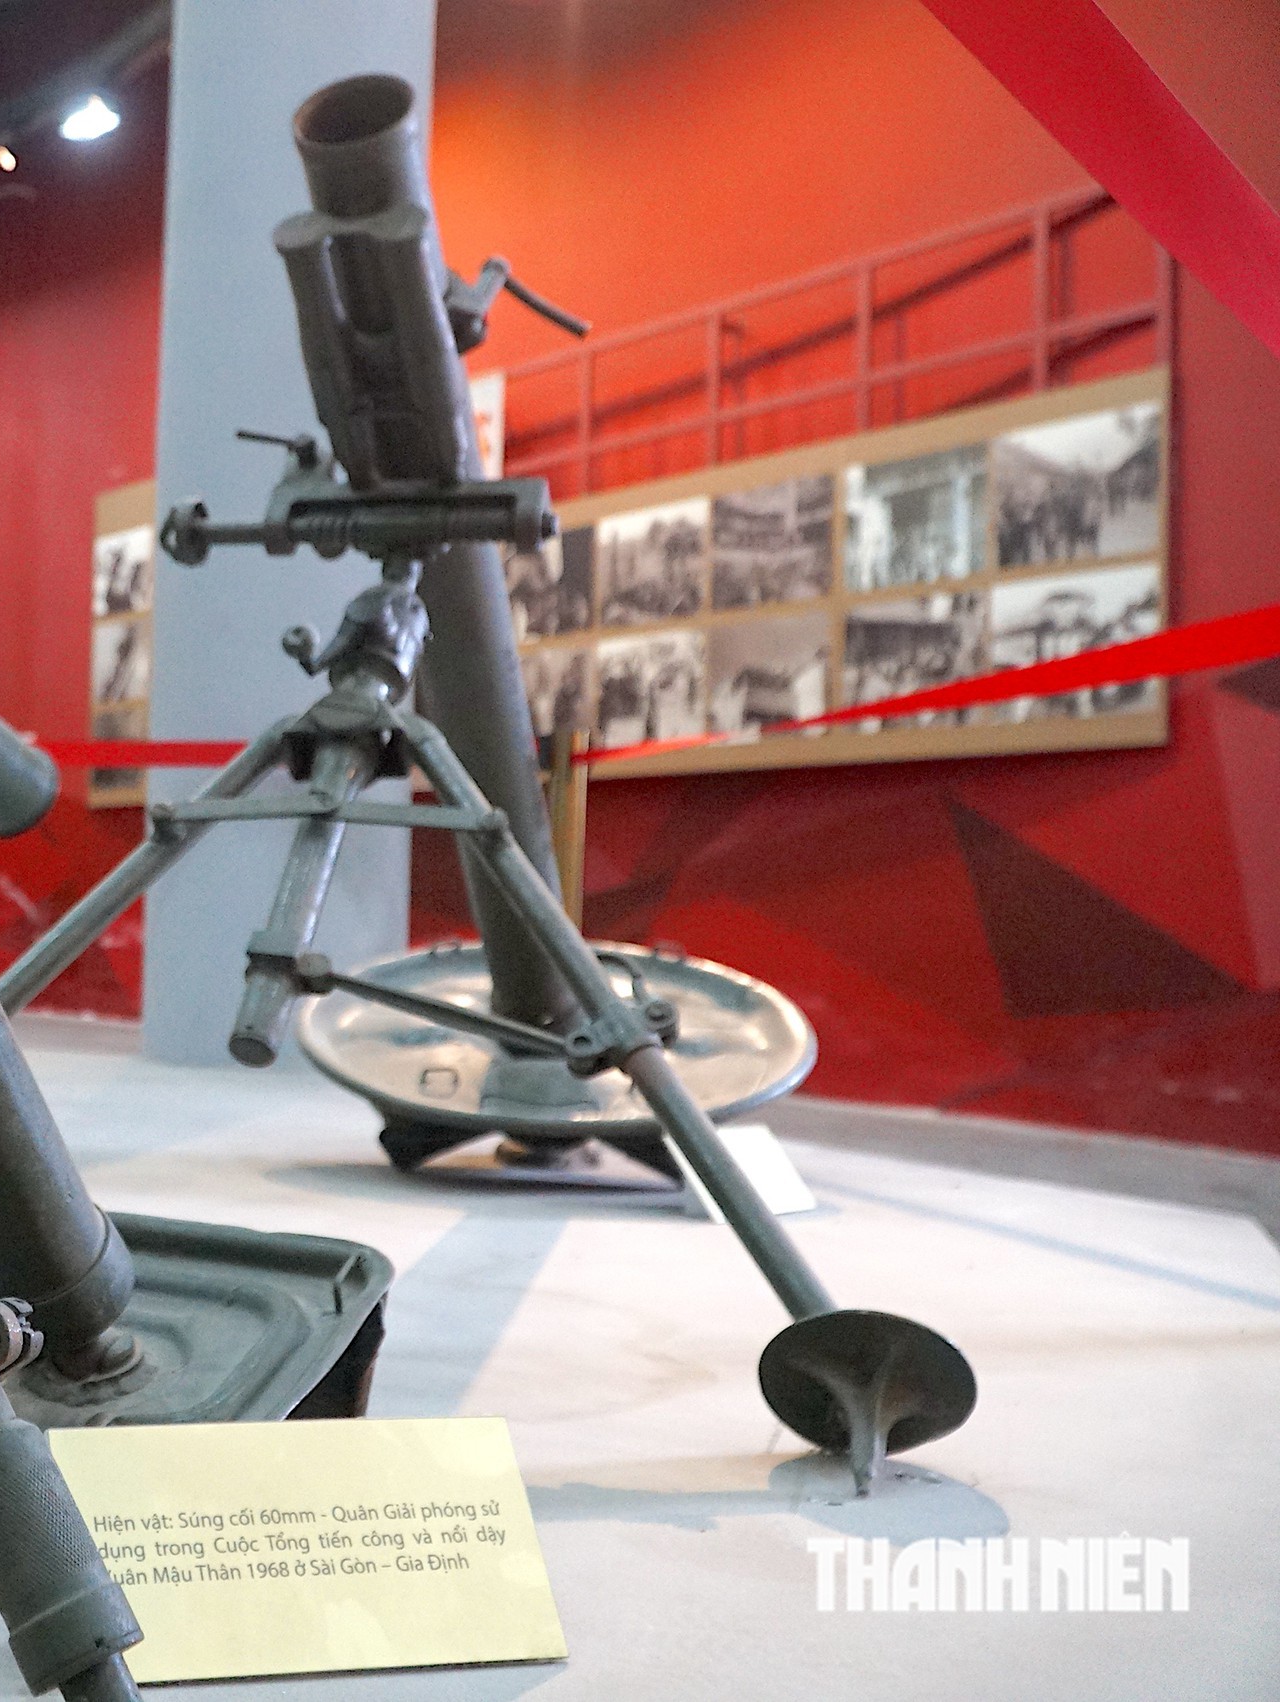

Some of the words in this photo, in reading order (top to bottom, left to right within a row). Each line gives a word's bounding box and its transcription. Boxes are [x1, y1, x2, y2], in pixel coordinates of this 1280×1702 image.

[94, 1515, 136, 1536] Hiện
[141, 1513, 174, 1534] vật:
[178, 1512, 224, 1531] Súng
[229, 1508, 255, 1526] cối
[260, 1508, 316, 1526] 60mm
[332, 1504, 379, 1524] Quân
[383, 1501, 417, 1520] Giải
[422, 1501, 477, 1522] phóng
[481, 1500, 500, 1517] sử
[98, 1542, 146, 1563] dụng
[155, 1541, 205, 1559] trong
[214, 1536, 260, 1556] Cuộc
[265, 1531, 310, 1554] Tổng
[319, 1529, 353, 1549] tiến
[361, 1530, 405, 1550] công
[413, 1528, 433, 1545] và
[441, 1524, 468, 1544] nổi
[476, 1525, 506, 1546] dậy
[153, 1565, 193, 1587] Mậu
[195, 1563, 242, 1582] Thân
[247, 1561, 290, 1579] 1968
[294, 1559, 307, 1576] ở
[311, 1559, 336, 1576] Sài
[340, 1556, 377, 1574] Gòn
[396, 1554, 424, 1572] Gia
[427, 1552, 470, 1574] Định
